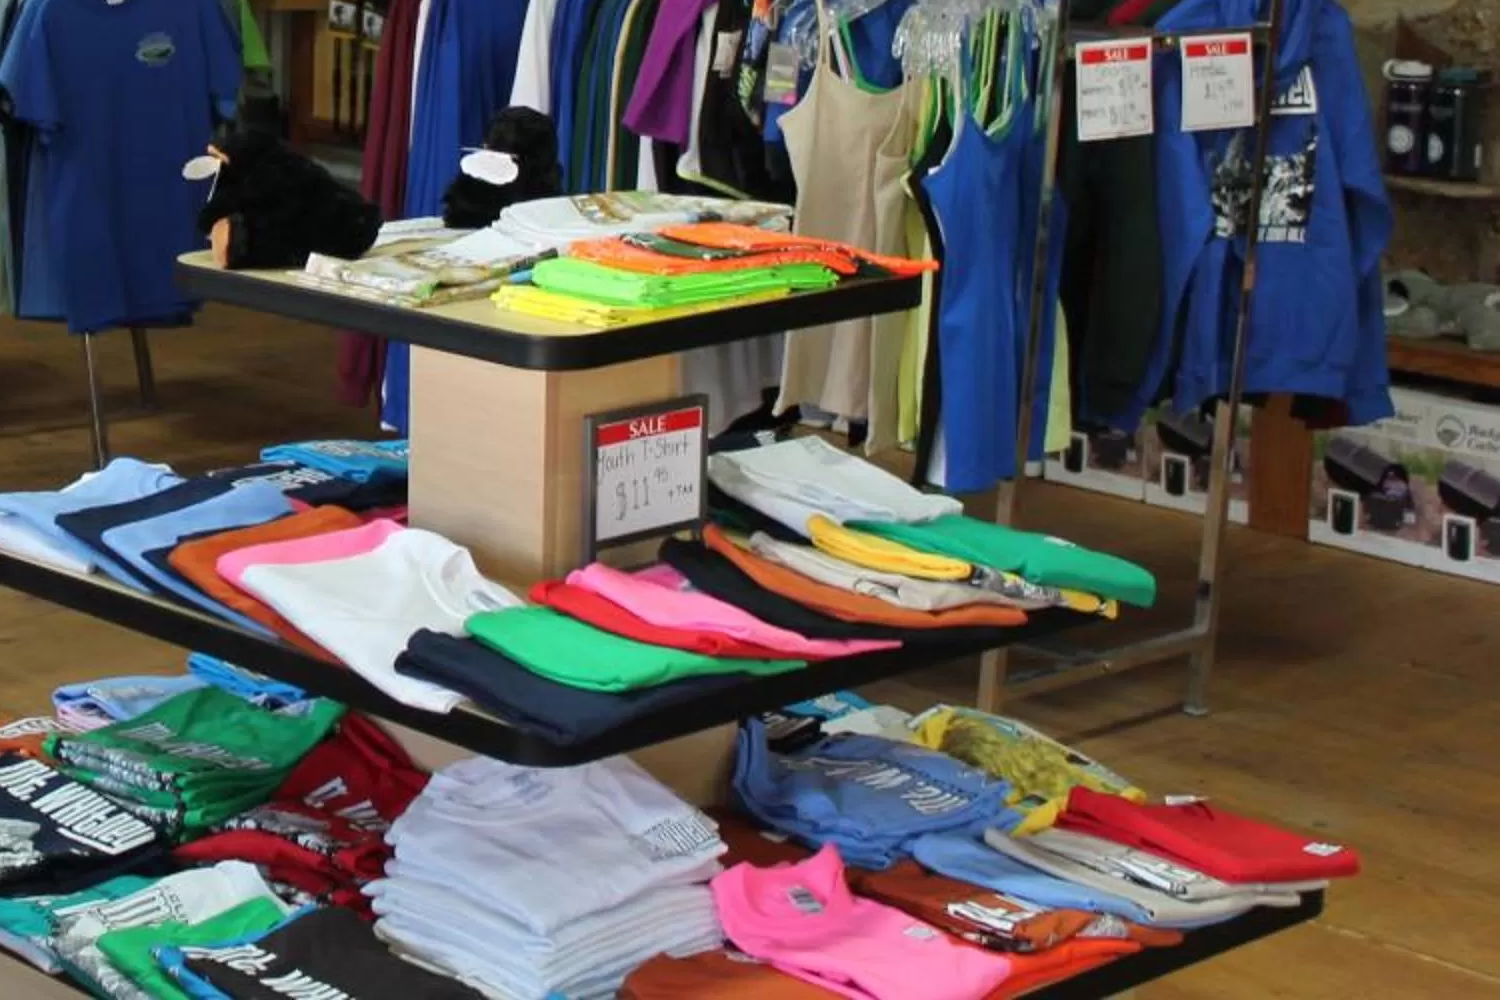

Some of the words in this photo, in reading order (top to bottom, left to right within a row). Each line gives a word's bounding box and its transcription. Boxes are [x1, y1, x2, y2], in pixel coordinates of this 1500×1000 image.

[1104, 48, 1129, 62] SALE
[1205, 42, 1228, 56] SALE
[629, 414, 667, 439] SALE
